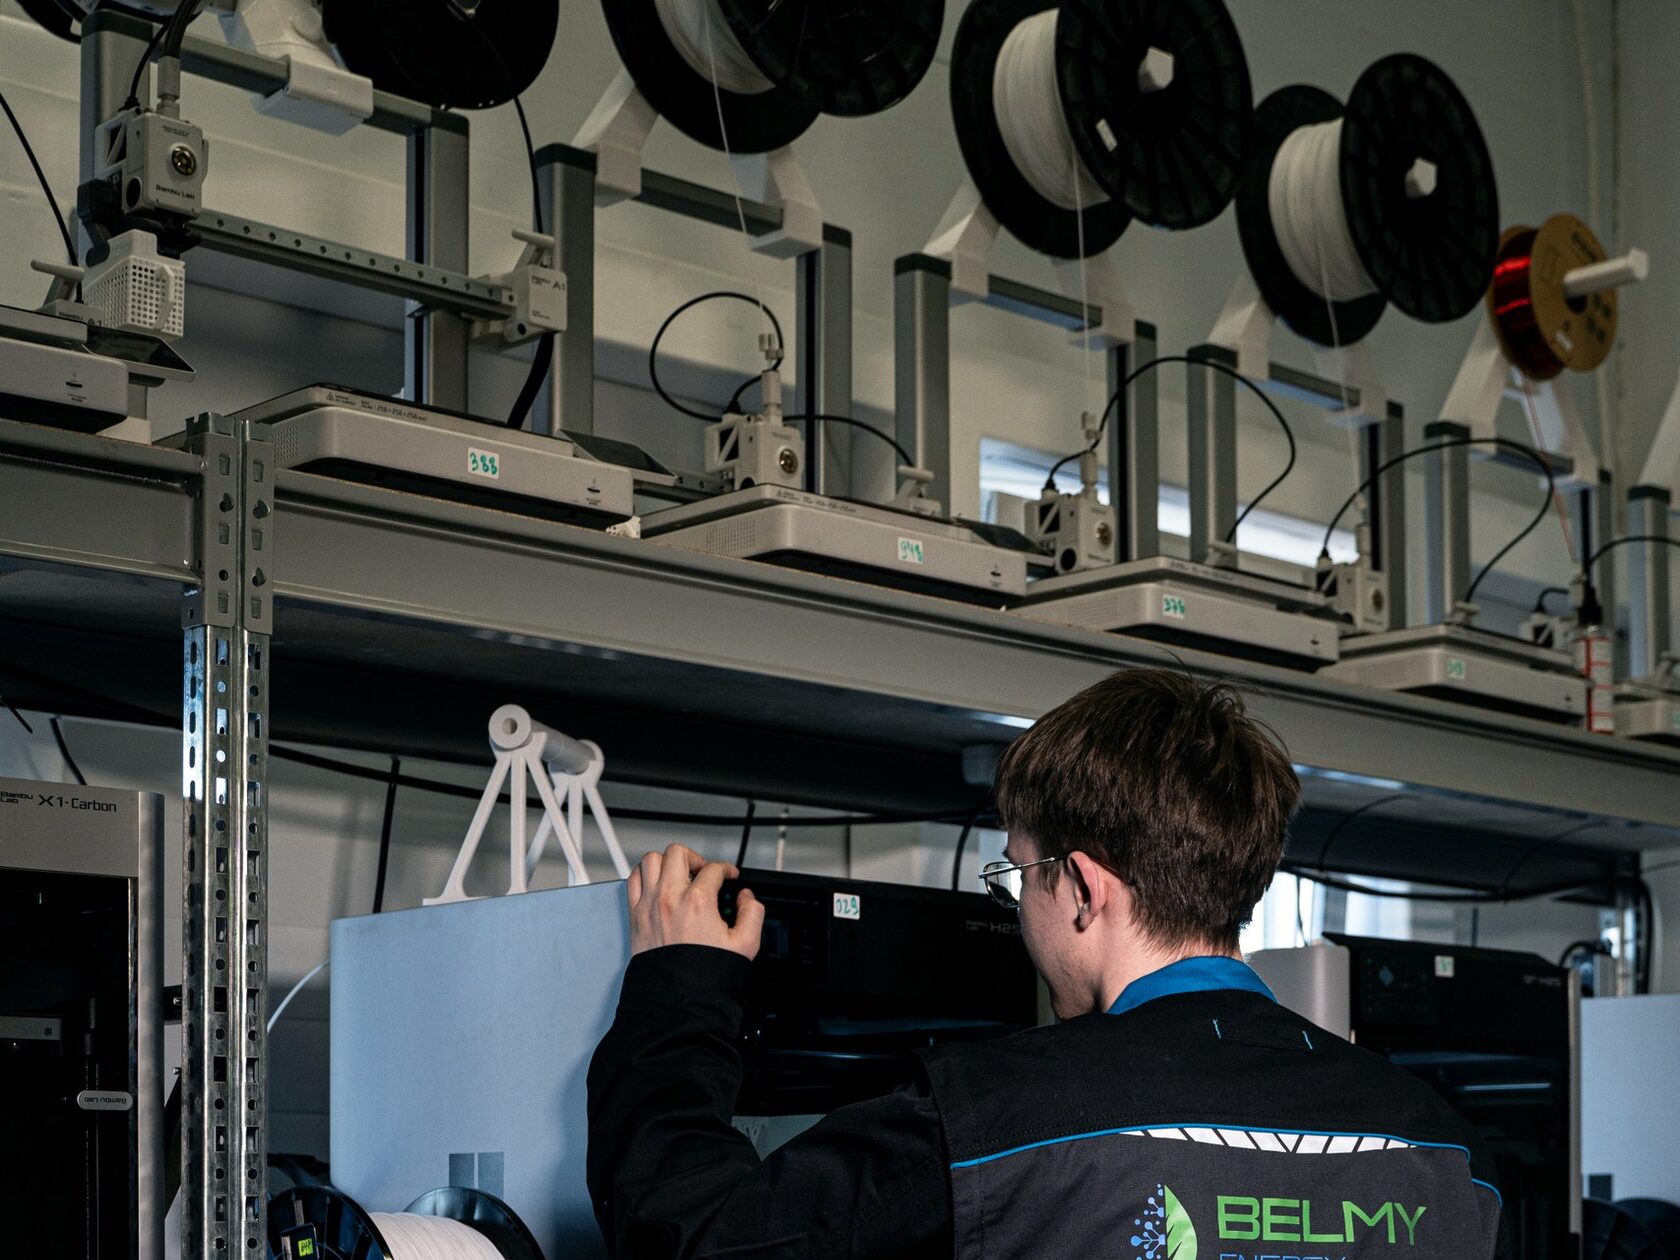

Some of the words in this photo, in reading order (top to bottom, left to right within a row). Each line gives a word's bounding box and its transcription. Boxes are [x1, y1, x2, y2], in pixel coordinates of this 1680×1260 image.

[470, 452, 498, 475] 388
[0, 791, 33, 800] Bambu
[0, 796, 19, 804] Lab
[84, 1096, 99, 1104] Lab
[100, 1096, 127, 1105] Bambu
[1217, 1195, 1427, 1246] BELMY
